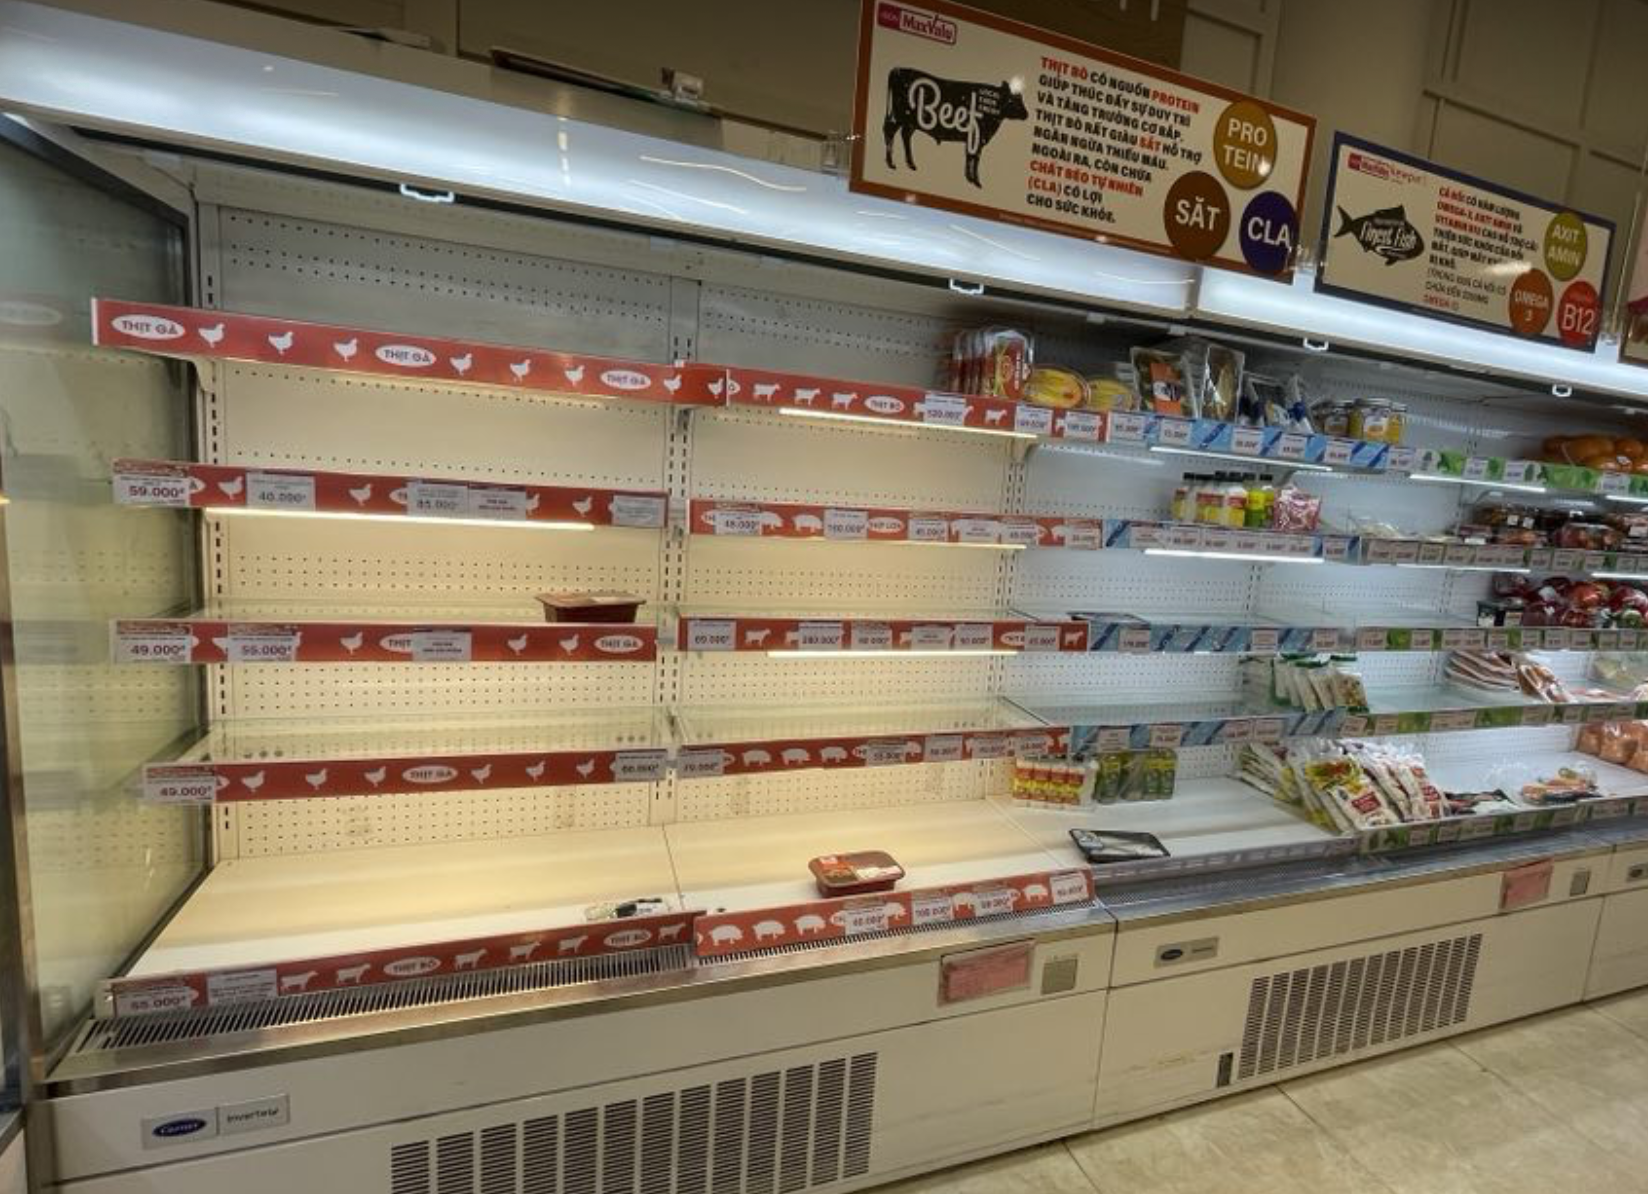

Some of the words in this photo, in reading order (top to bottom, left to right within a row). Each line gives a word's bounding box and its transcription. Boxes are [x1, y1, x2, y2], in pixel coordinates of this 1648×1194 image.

[902, 13, 954, 40] MaxValu
[1041, 56, 1069, 77] THỊT
[1090, 70, 1107, 85] CÓ
[1152, 90, 1200, 114] PROTEIN
[1037, 90, 1054, 106] VÀ
[1141, 120, 1158, 134] CƠ
[1039, 74, 1070, 91] GIÚP
[1072, 83, 1106, 101] THÚC
[1149, 106, 1173, 121] DUY
[1173, 113, 1191, 127] TRÌ
[908, 77, 984, 155] Beef
[1035, 108, 1063, 127] THỊT
[1065, 116, 1083, 131] BÒ
[1180, 149, 1203, 165] TRỢ
[1227, 117, 1268, 147] PRO
[1031, 142, 1071, 162] NGOÀI
[1073, 151, 1092, 169] RA,
[1094, 158, 1119, 174] CÒN
[1120, 165, 1151, 182] CHỨA
[1223, 145, 1267, 173] TEIN
[1027, 175, 1062, 196] (CLA)
[1063, 183, 1081, 199] CÓ
[1082, 188, 1103, 204] LỢI
[1065, 166, 1089, 184] BÉO
[1091, 173, 1108, 189] TỰ
[1026, 192, 1053, 209] CHO
[1055, 197, 1079, 215] SỨC
[1248, 216, 1290, 248] CLA
[1552, 224, 1579, 242] AXIT
[1548, 245, 1583, 266] AMIN
[122, 320, 151, 333] THỊT
[1562, 302, 1594, 335] B12
